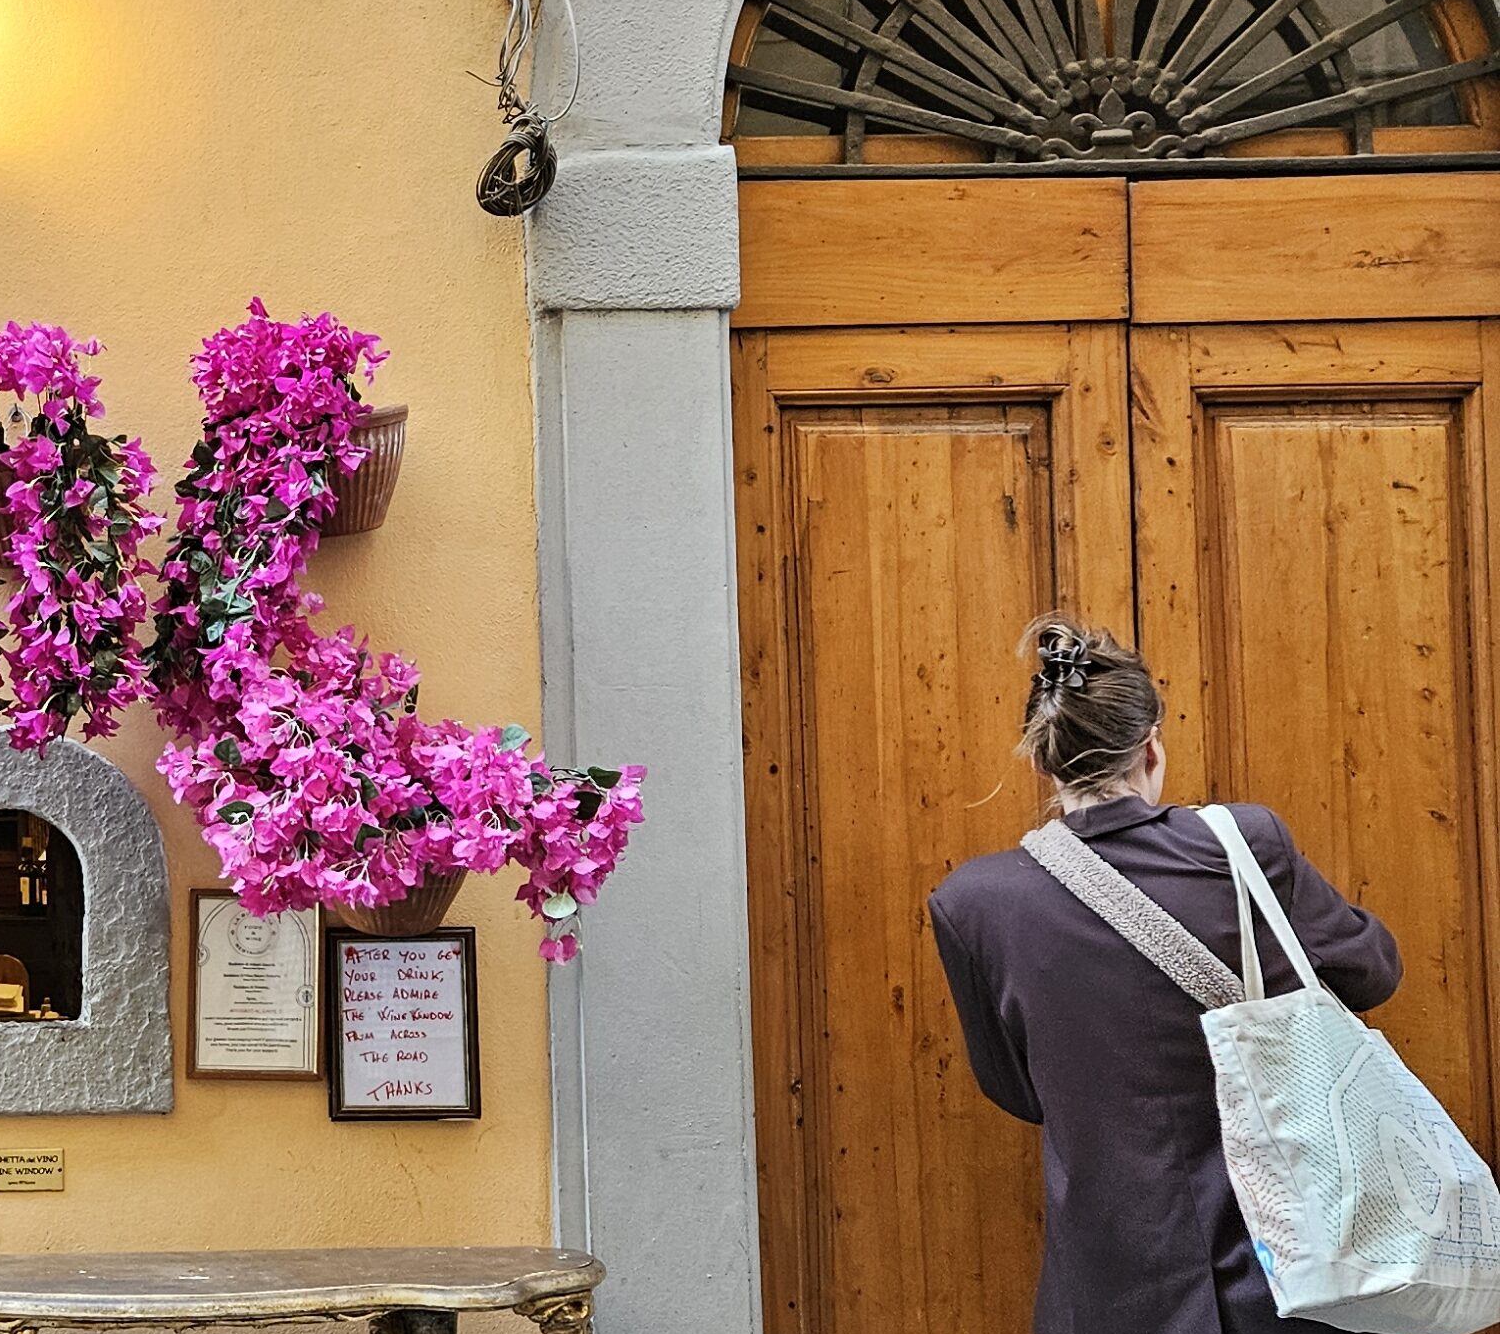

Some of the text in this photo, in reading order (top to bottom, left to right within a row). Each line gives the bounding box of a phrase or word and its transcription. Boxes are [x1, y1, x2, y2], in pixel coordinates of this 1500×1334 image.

[345, 946, 390, 964] AFTER
[399, 950, 426, 963] YOU
[345, 969, 377, 985] YOUR
[344, 987, 439, 1003] PLEASE ADMIRE
[343, 1008, 365, 1021] THE
[390, 1029, 428, 1040] ACROSS
[360, 1050, 429, 1063] THE ROAD
[366, 1080, 433, 1101] THANKS
[36, 1155, 58, 1163] VINO
[15, 1167, 54, 1175] WINDOW
